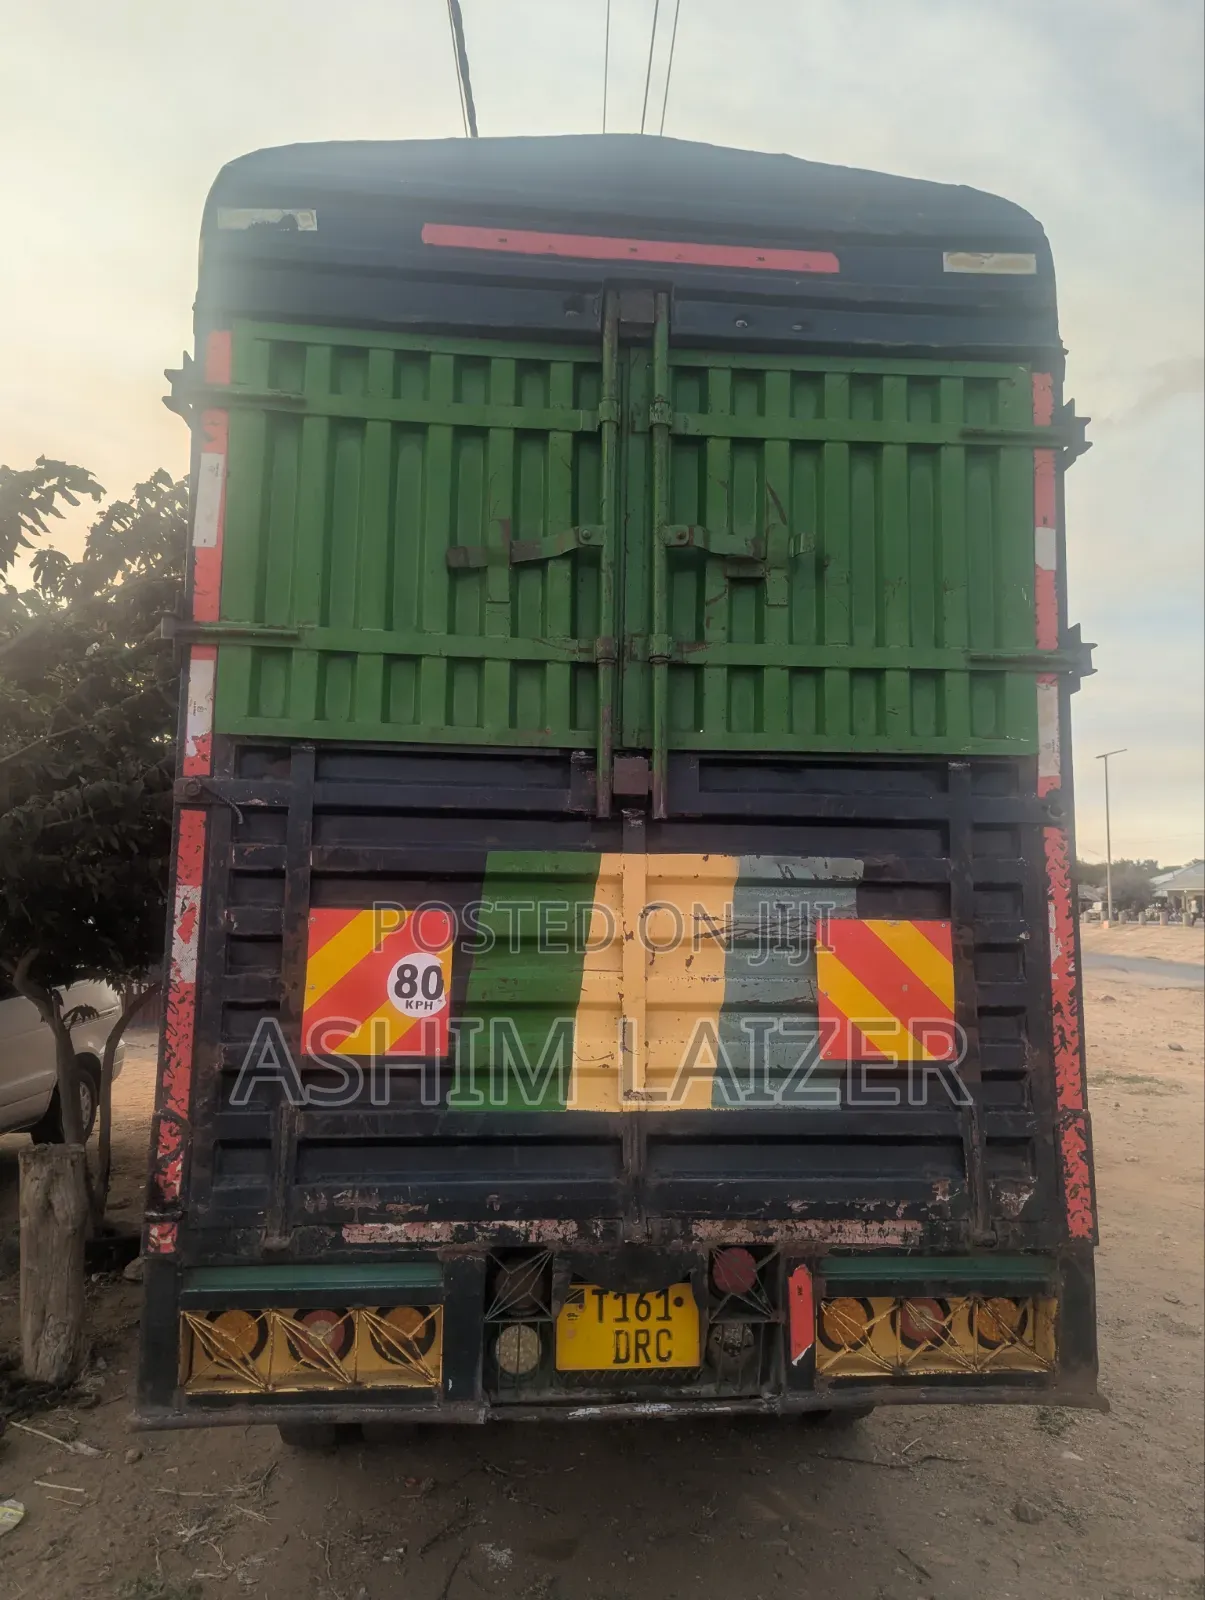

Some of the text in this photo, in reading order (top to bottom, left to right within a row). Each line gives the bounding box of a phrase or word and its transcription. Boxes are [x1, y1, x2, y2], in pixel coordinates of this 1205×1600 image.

[394, 963, 444, 1000] 80
[405, 999, 434, 1011] KPH
[591, 1288, 672, 1323] T161
[613, 1328, 673, 1364] DRC
